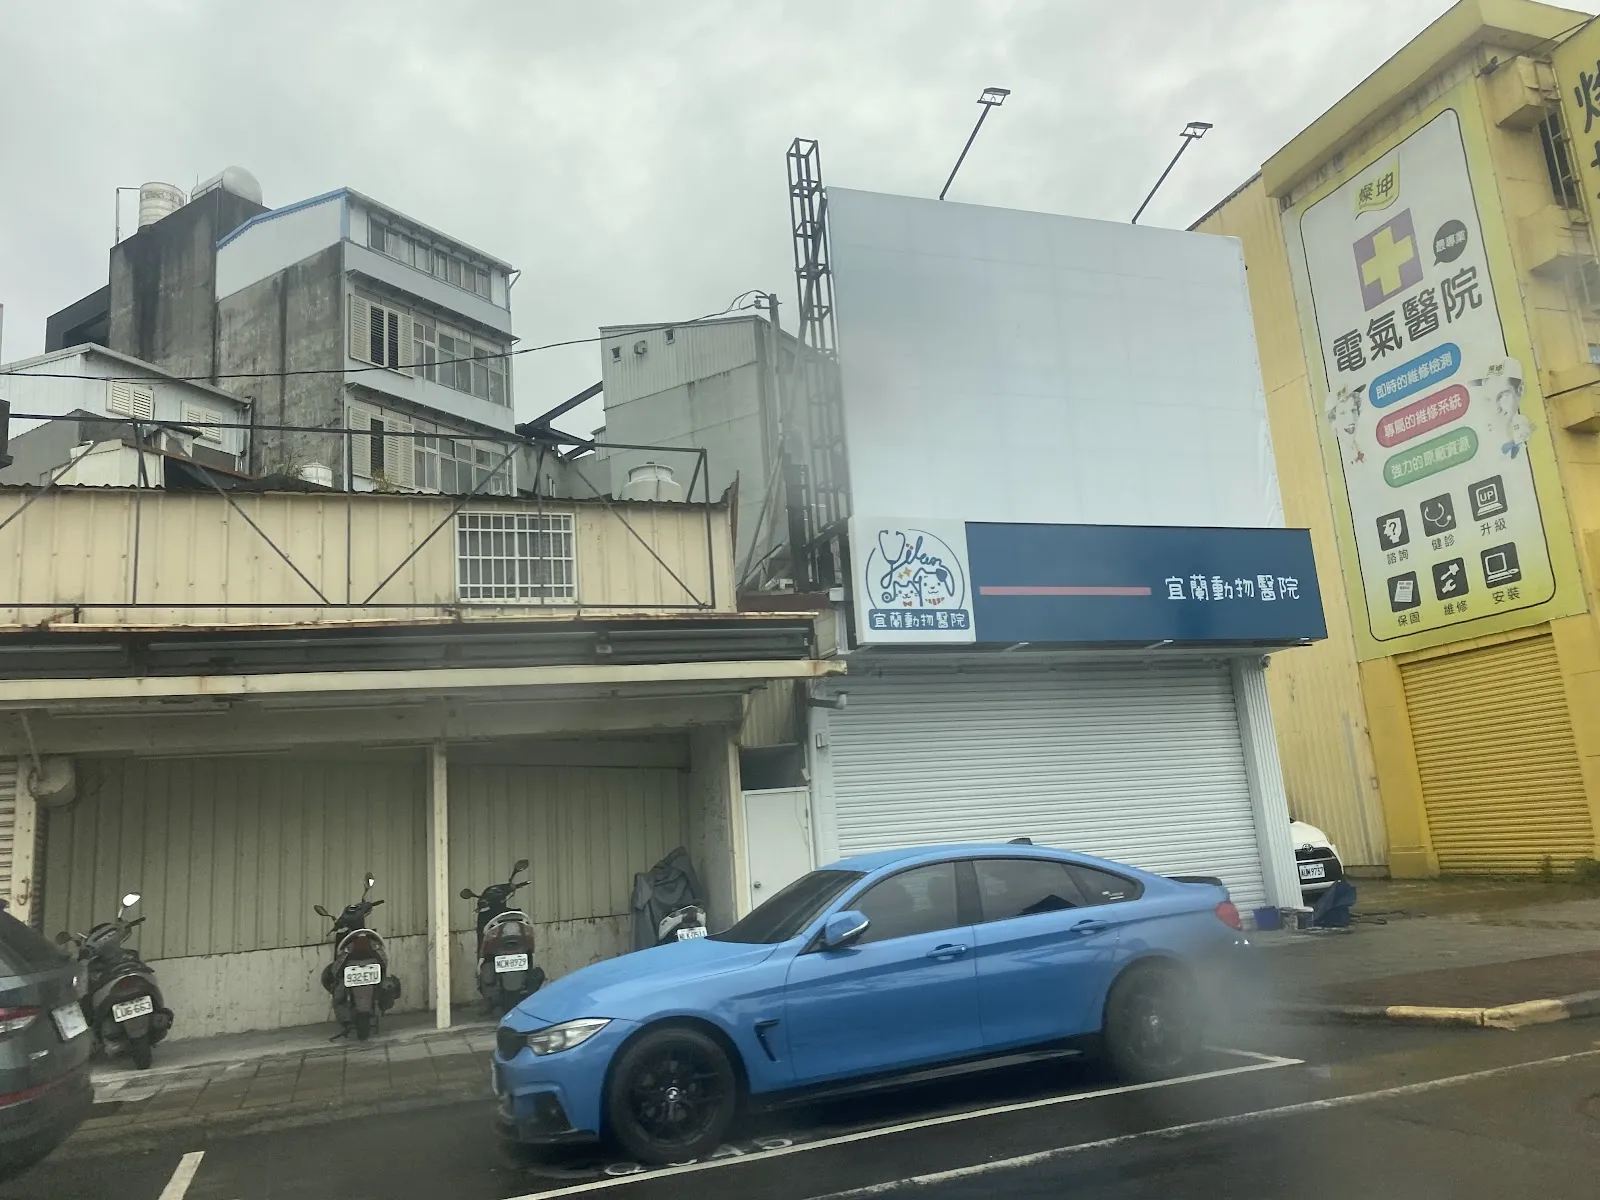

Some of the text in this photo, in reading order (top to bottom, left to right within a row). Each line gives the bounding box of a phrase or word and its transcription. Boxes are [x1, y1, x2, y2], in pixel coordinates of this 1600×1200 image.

[1359, 171, 1395, 203] 燦坤
[1332, 266, 1483, 373] 電氣醫院
[1375, 351, 1453, 400] 即時的維修檢測
[1384, 393, 1463, 439] 專屬的維修系統
[1391, 435, 1472, 480] 強力的原廠資源
[1479, 490, 1495, 502] UP
[1480, 517, 1507, 537] 升級
[1431, 534, 1456, 551] 健診
[1386, 549, 1409, 565] 諮詢
[1165, 574, 1300, 601] 宜蘭動物醫院
[1492, 587, 1521, 604] 安裝
[1443, 600, 1468, 616] 維修
[872, 611, 966, 628] 宜蘭動物醫院
[1397, 611, 1421, 627] 保固
